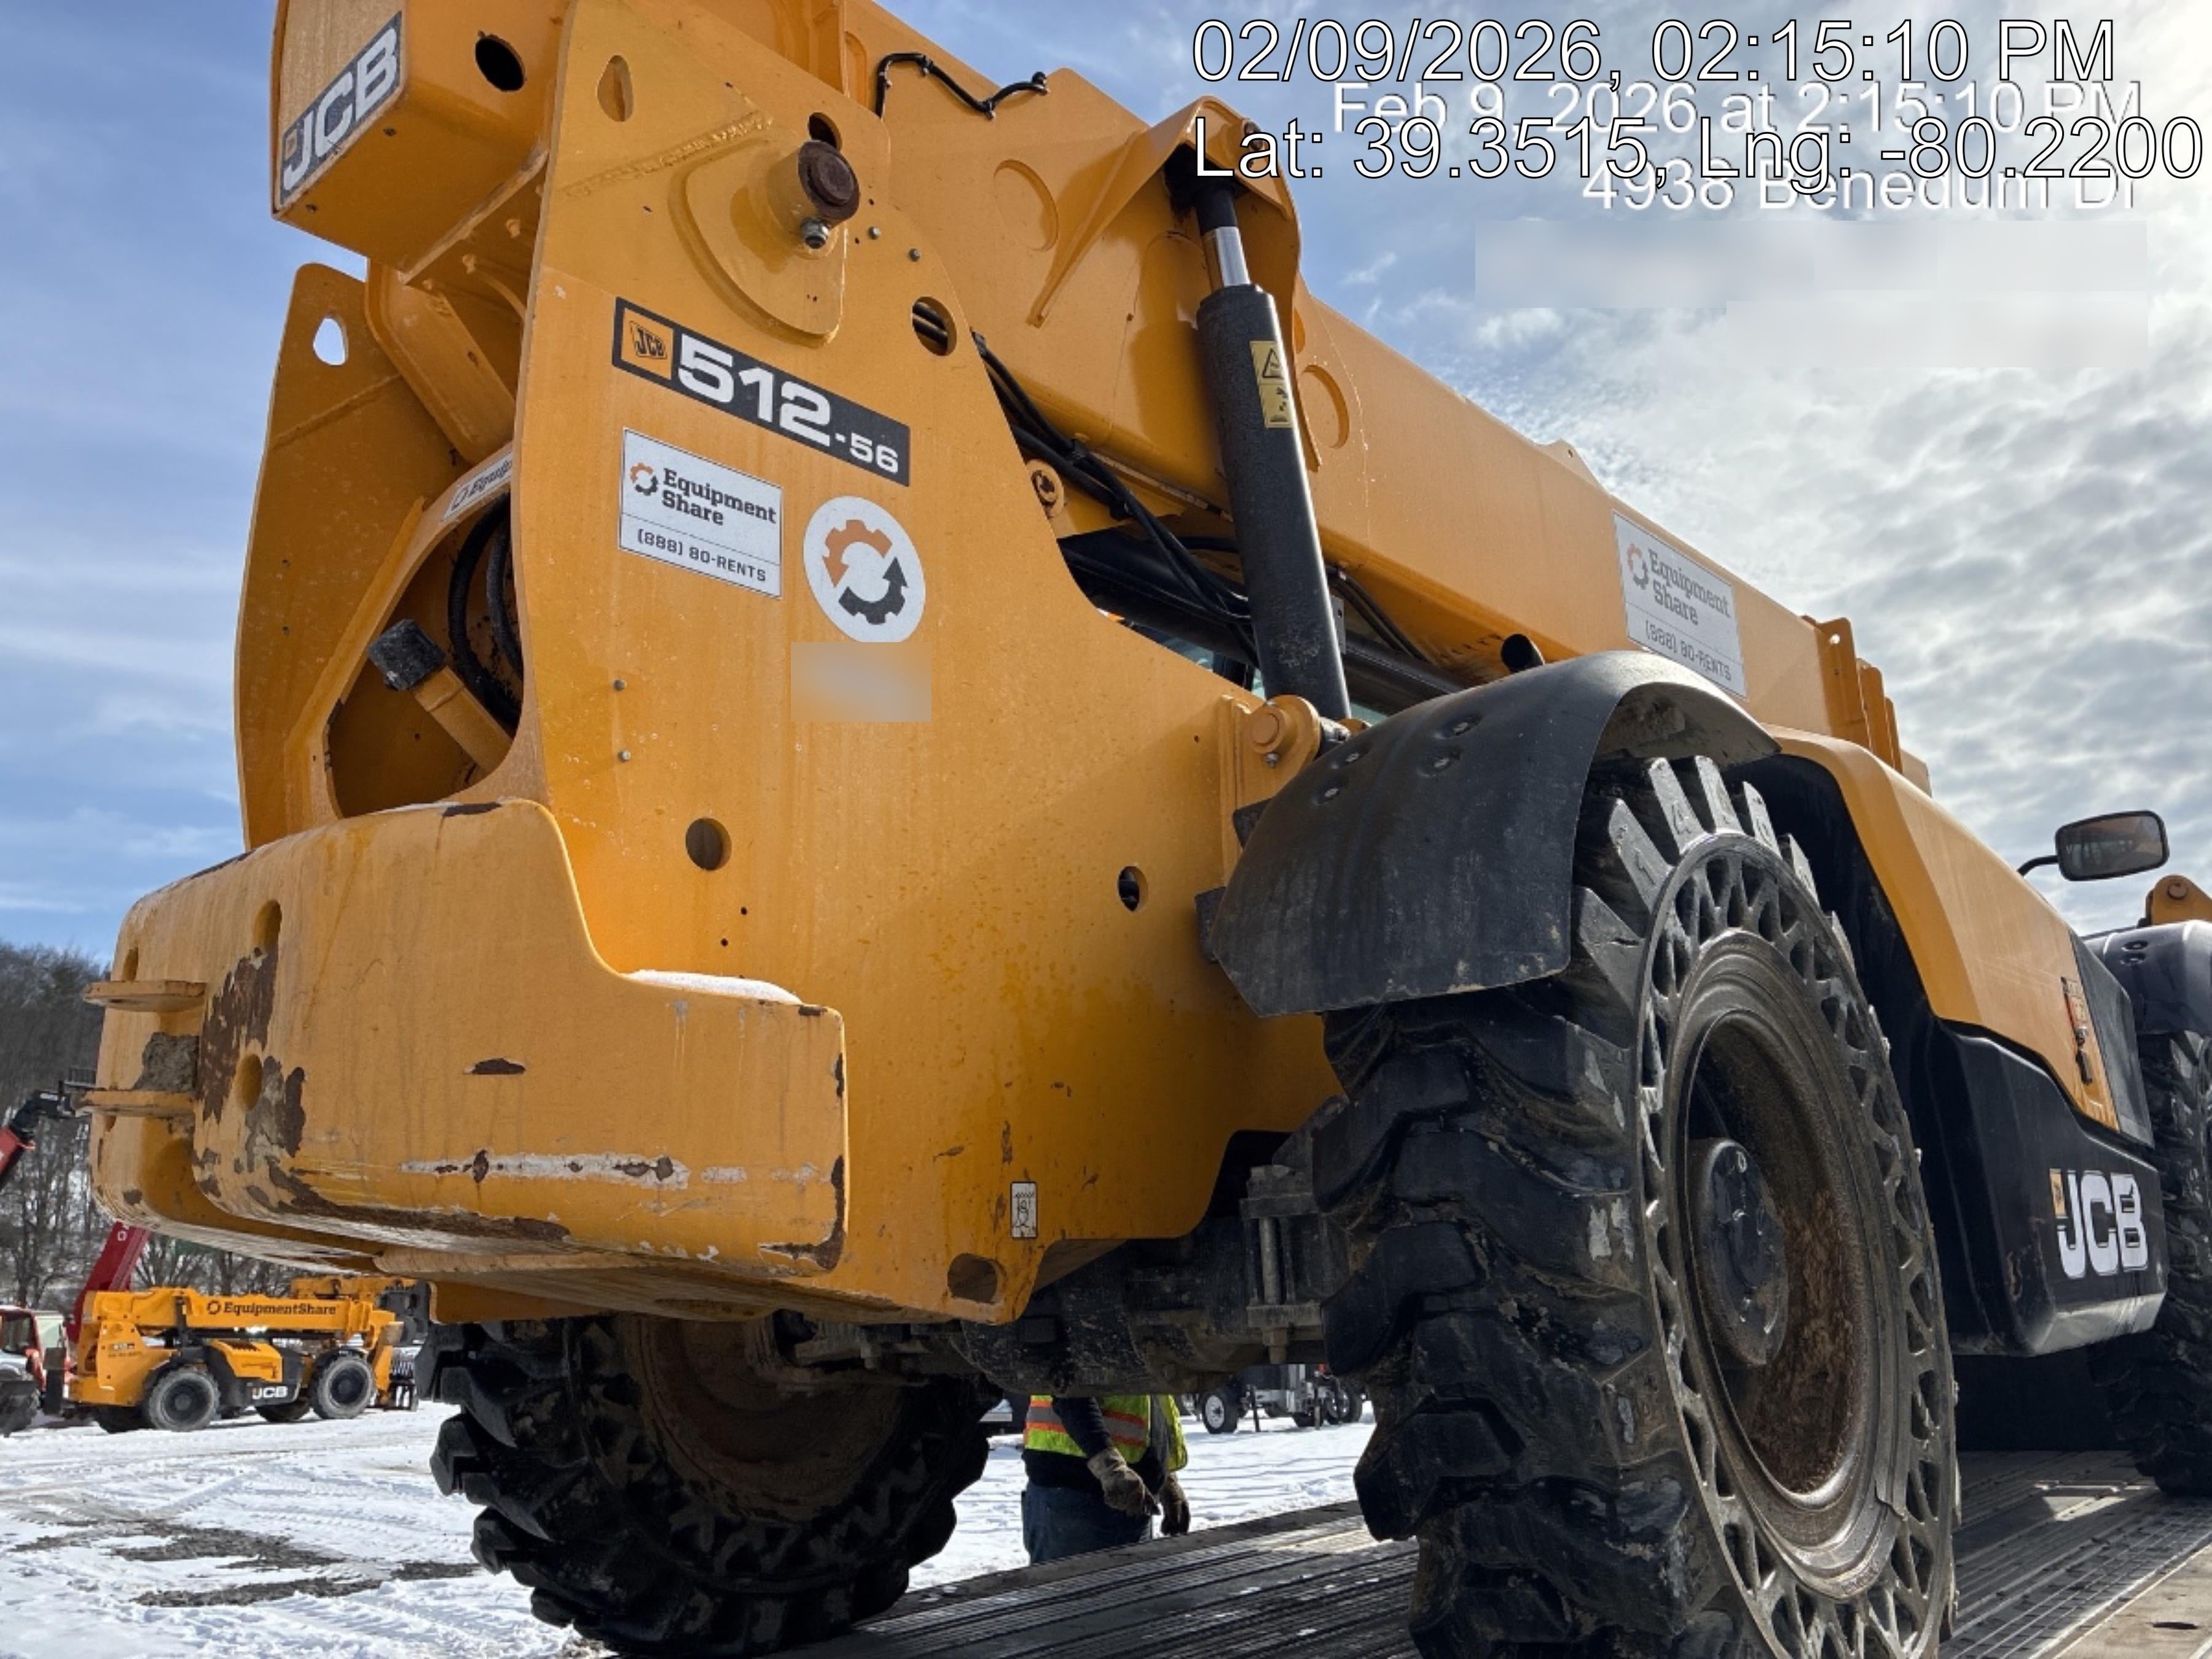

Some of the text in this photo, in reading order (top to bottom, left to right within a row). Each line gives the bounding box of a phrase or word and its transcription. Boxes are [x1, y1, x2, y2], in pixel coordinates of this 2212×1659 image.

[283, 28, 397, 191] JCB
[632, 324, 665, 358] JCB
[662, 490, 723, 525] Share
[664, 468, 777, 524] Equipment
[637, 528, 766, 581] (888) 80-RENTS
[1648, 549, 1731, 618] Equipment
[1653, 579, 1698, 625] Share
[1681, 641, 1732, 681] 80-RENTS
[2057, 1169, 2149, 1279] JCB
[224, 1301, 337, 1316] EquipmentShare
[252, 1386, 288, 1400] JCB
